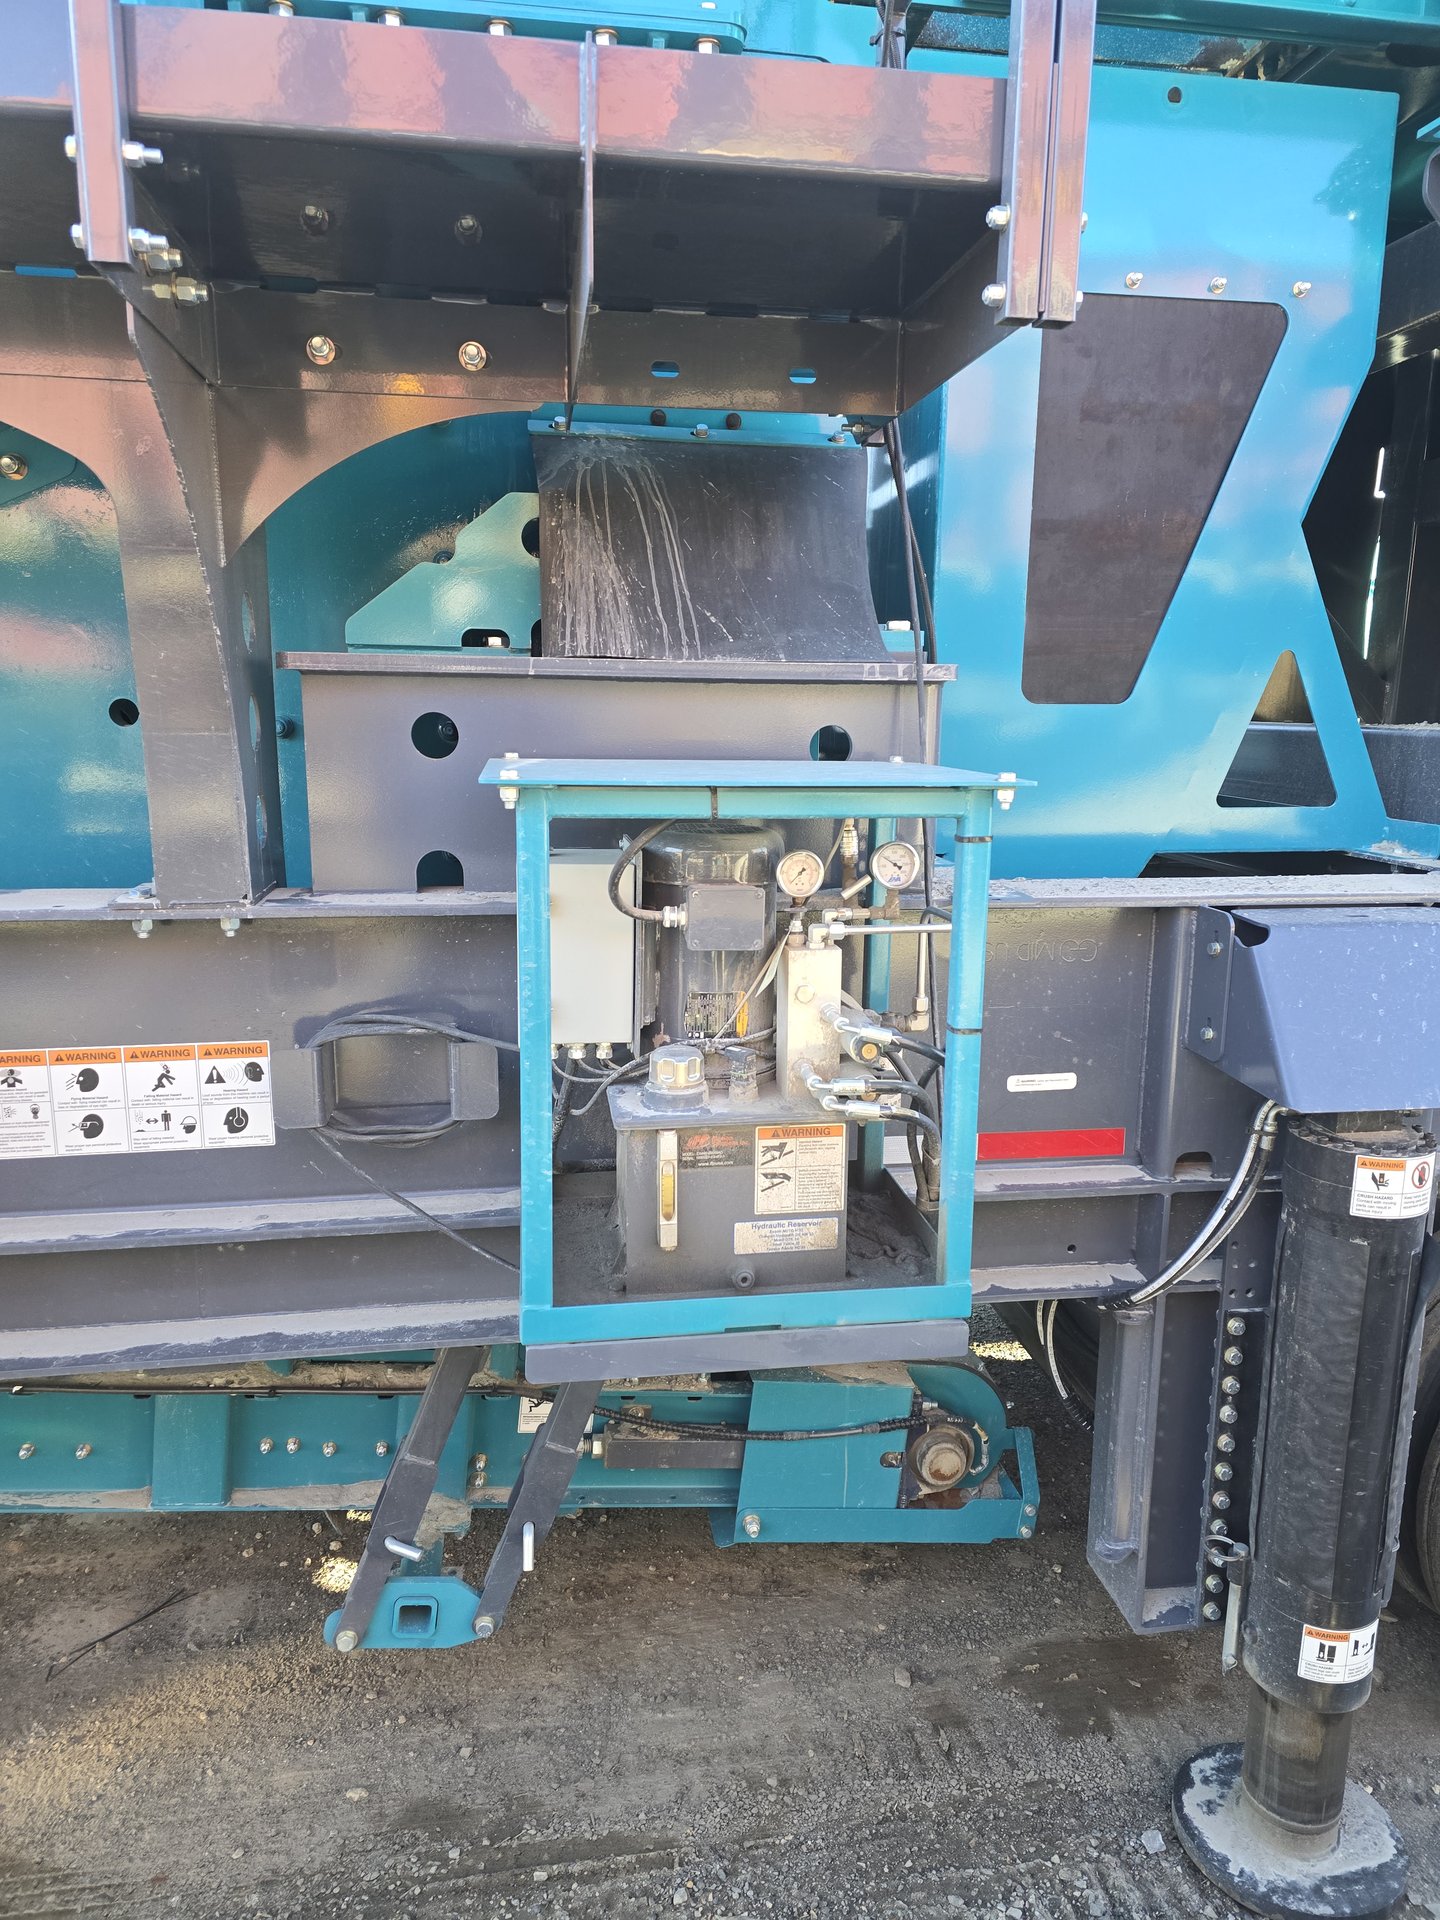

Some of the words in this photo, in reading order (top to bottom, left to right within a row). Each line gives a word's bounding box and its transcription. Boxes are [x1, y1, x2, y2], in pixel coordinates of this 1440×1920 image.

[140, 1048, 191, 1059] WARNING
[214, 1045, 263, 1056] WARNING
[65, 1051, 116, 1062] WARNING
[782, 1127, 831, 1137] WARNING
[1368, 1160, 1404, 1169] WARNING
[751, 1222, 785, 1231] Hydraulic
[1315, 1631, 1349, 1641] WARNING
